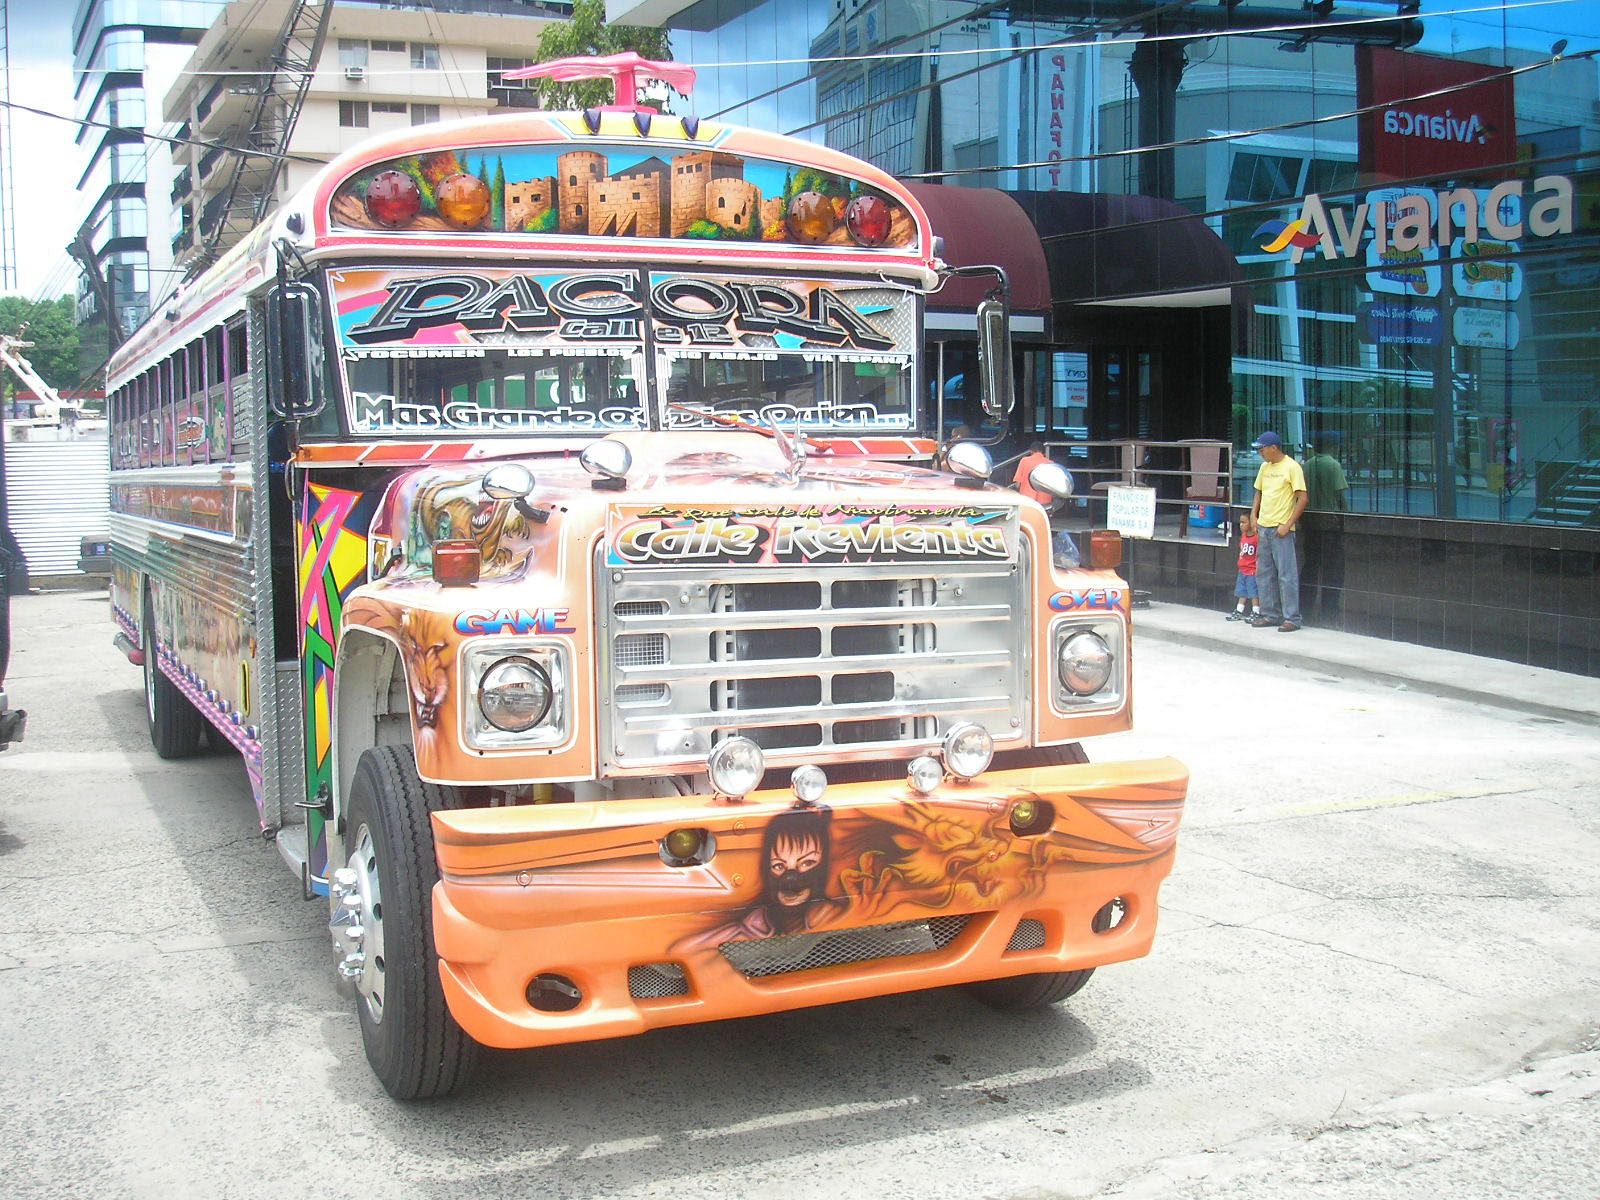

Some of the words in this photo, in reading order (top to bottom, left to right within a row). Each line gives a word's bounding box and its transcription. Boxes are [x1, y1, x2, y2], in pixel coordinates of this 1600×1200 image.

[1289, 175, 1573, 264] Avianca
[346, 271, 895, 349] PACORA
[357, 349, 486, 359] TOCUMEN
[508, 349, 544, 357] LOS
[550, 348, 630, 358] PUEBLOS
[668, 351, 701, 360] RIO
[708, 351, 779, 361] ABAJO
[802, 353, 834, 363] VIA
[353, 392, 441, 432] Mas
[442, 401, 596, 430] Grande
[799, 505, 823, 518] de
[616, 517, 764, 562] Calle
[773, 515, 1011, 562] Revienta
[1048, 586, 1126, 612] OVER
[453, 607, 577, 635] GAME
